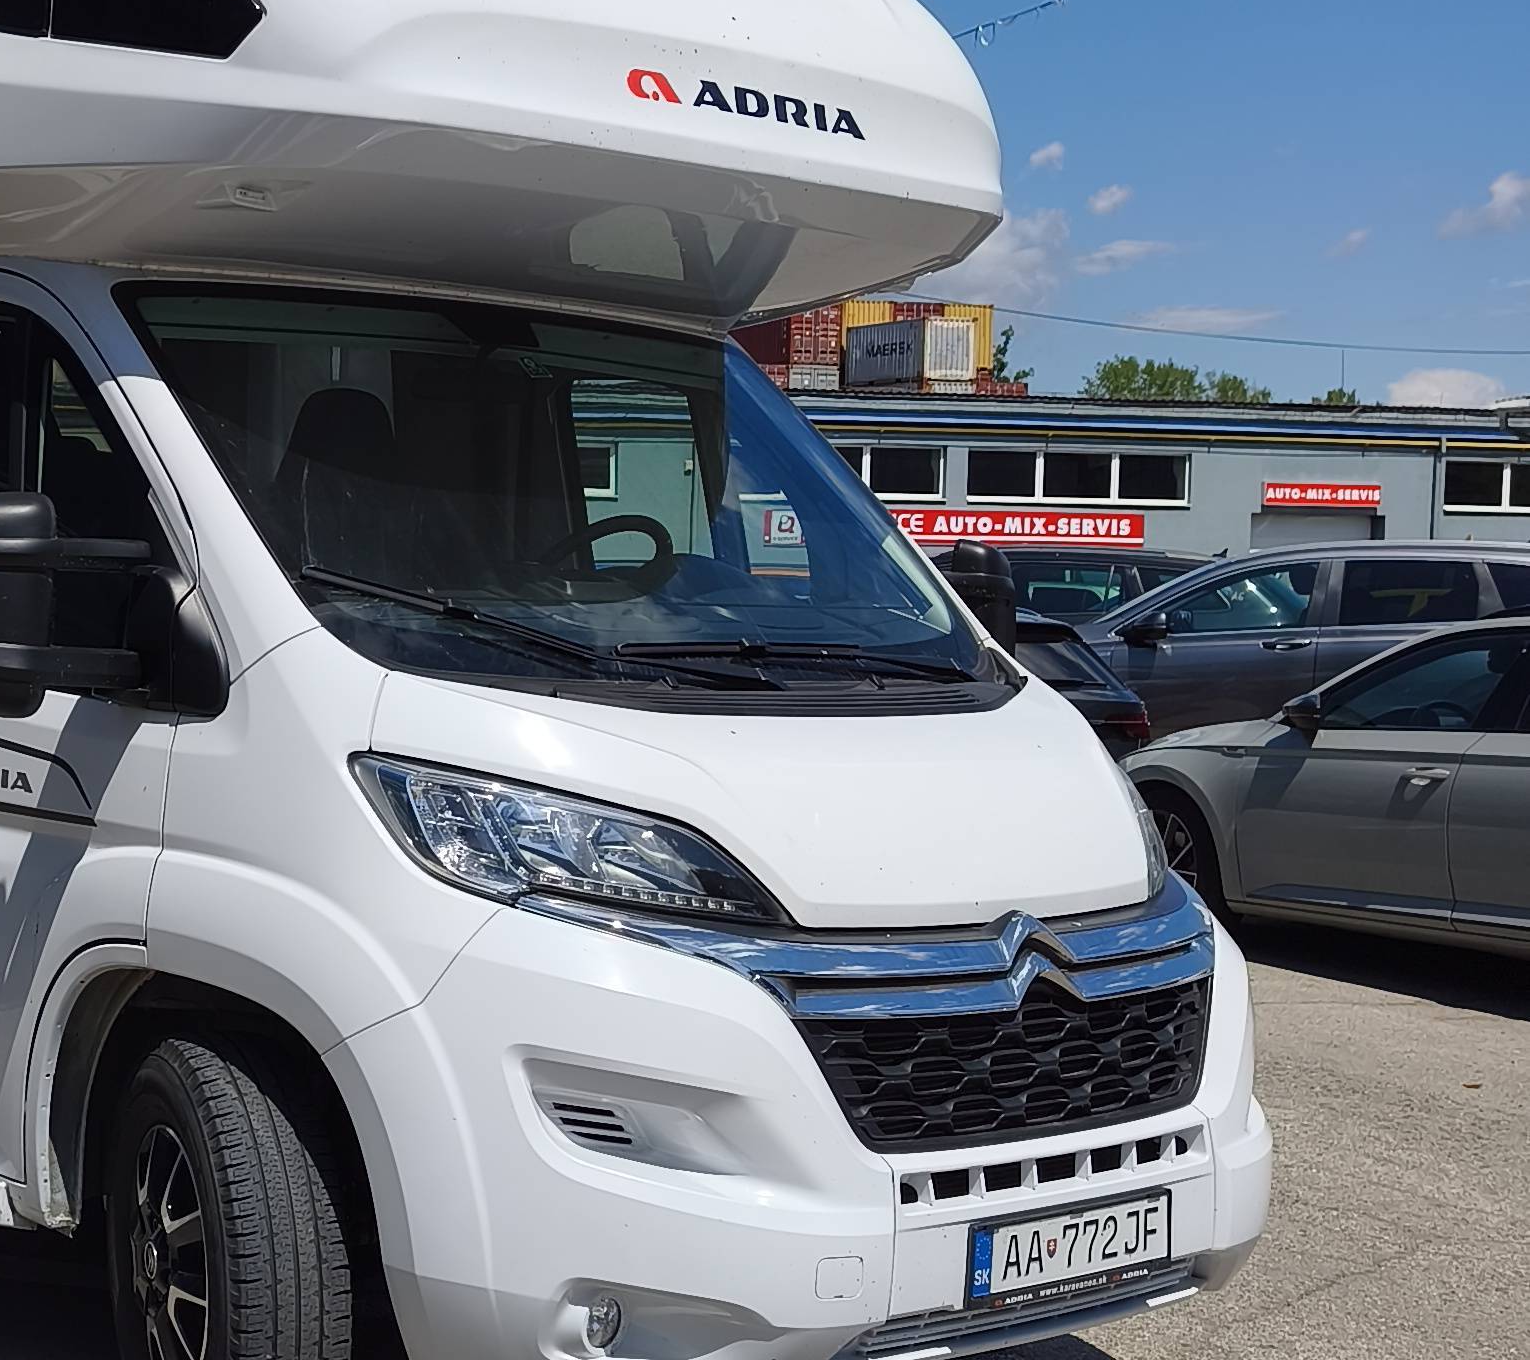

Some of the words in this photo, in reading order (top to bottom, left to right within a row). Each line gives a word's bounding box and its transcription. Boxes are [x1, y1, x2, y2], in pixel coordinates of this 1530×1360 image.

[693, 80, 867, 141] ADRIA
[867, 341, 913, 358] MAERSK
[1266, 487, 1380, 501] AUTO-MIX-SERVIS
[891, 512, 924, 533] CE
[932, 515, 1131, 536] AUTO-MIX-SERVIS
[974, 1269, 990, 1286] SK
